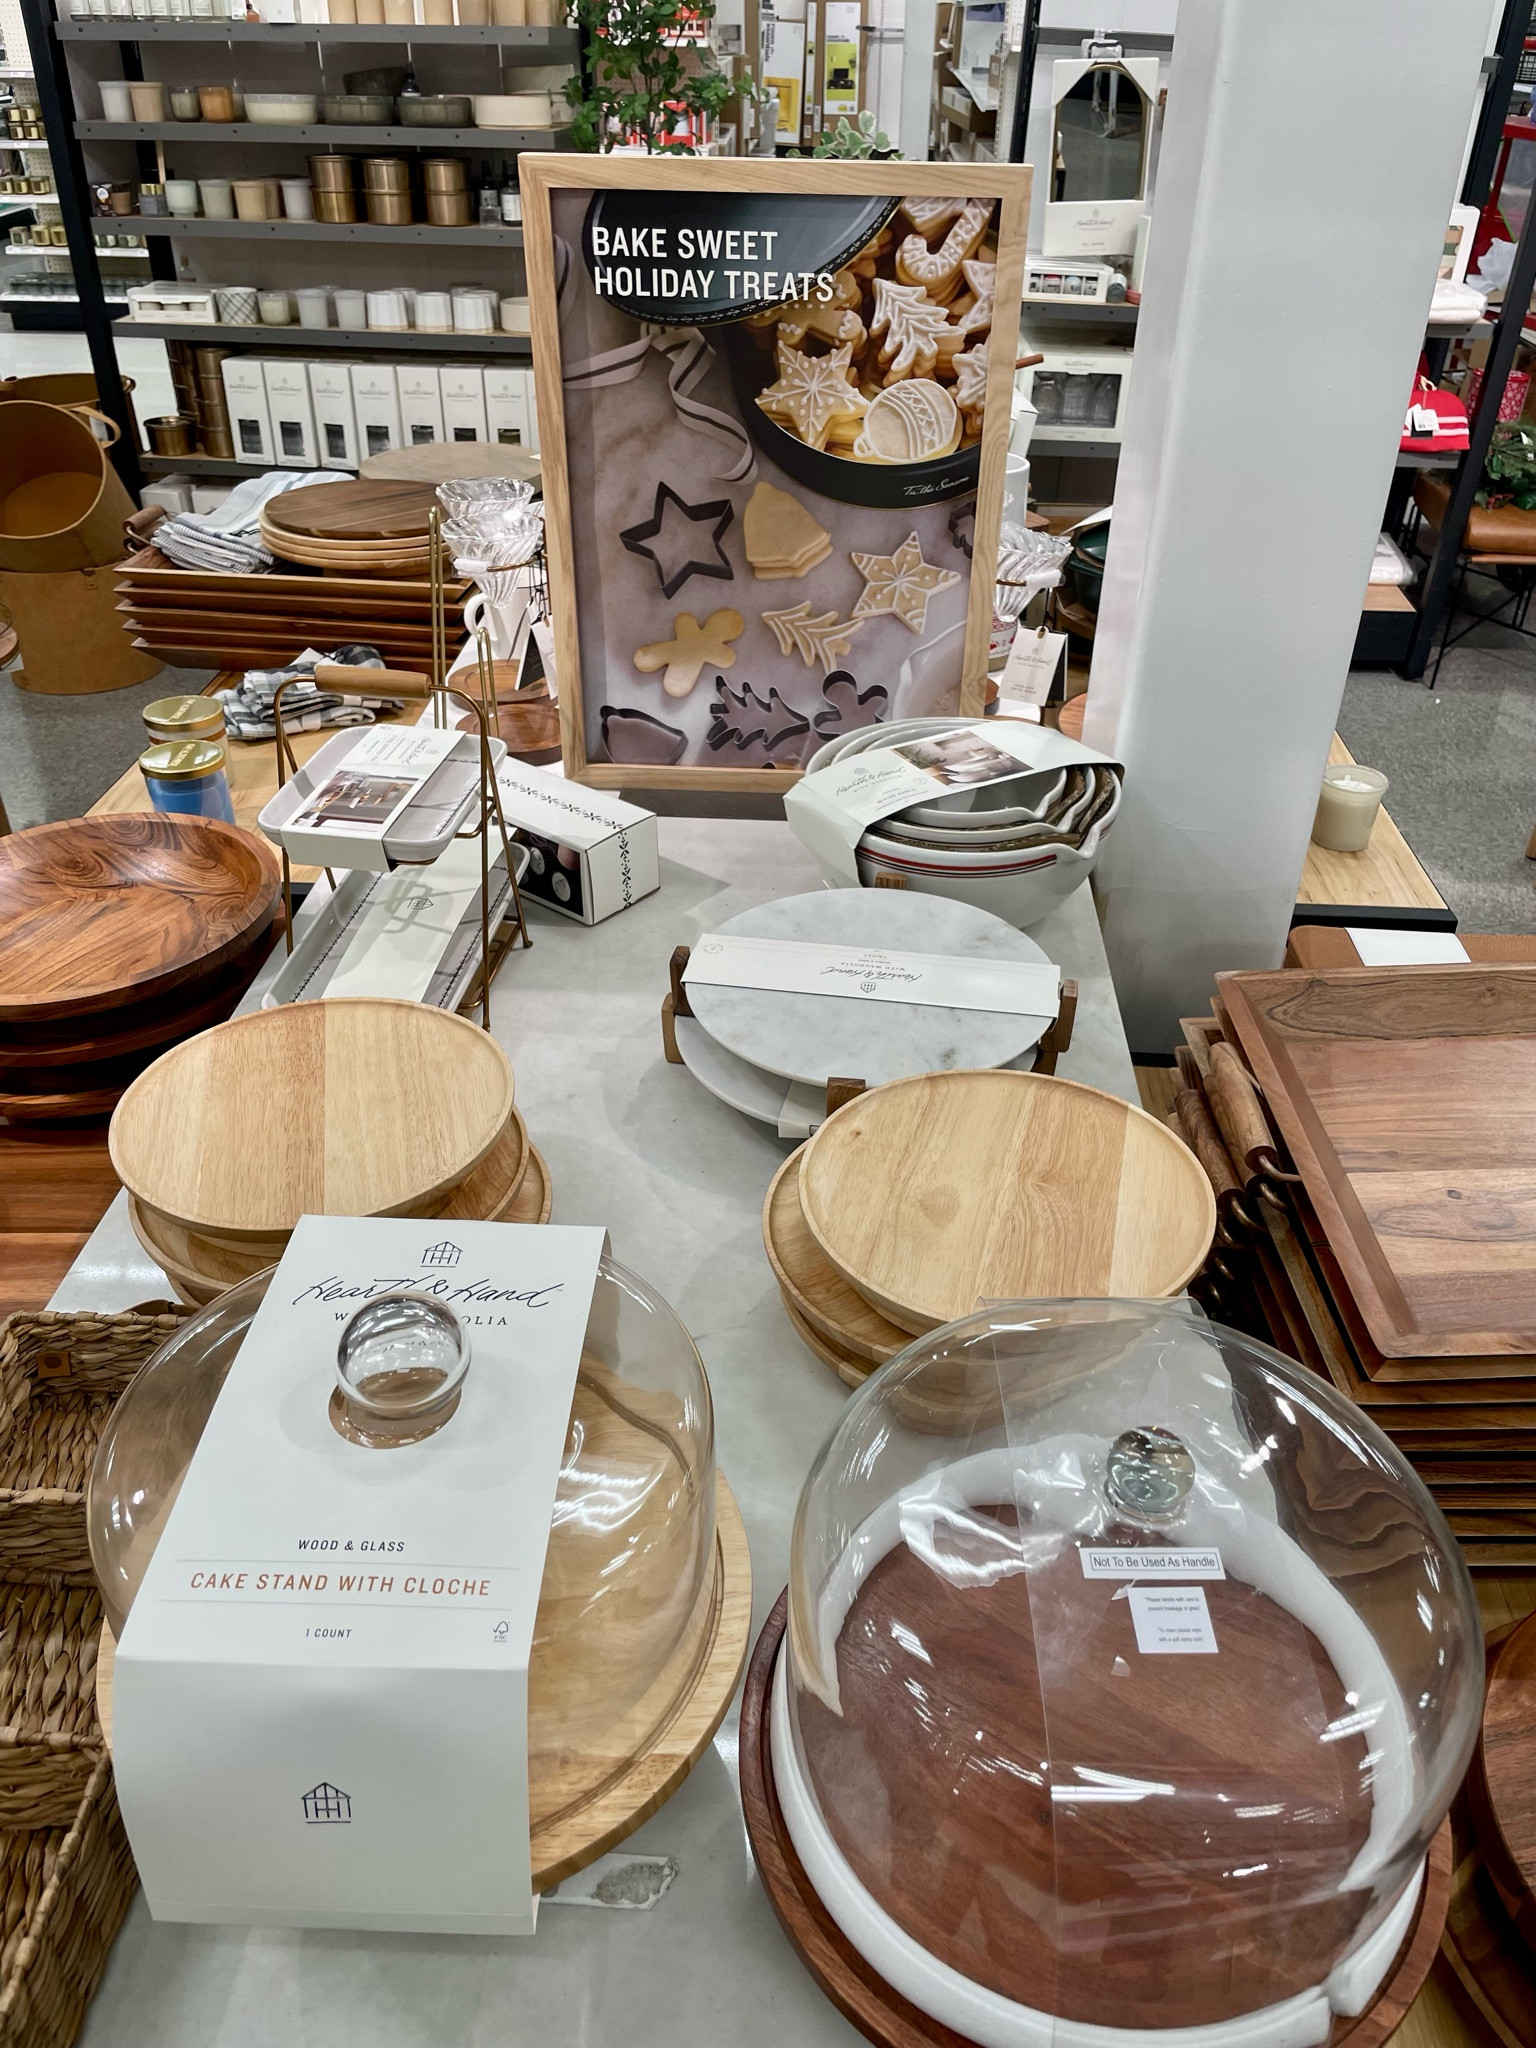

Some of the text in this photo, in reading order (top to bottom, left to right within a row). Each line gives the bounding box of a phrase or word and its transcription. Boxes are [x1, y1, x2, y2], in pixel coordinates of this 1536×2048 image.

[592, 226, 779, 261] BAKE SWEET
[594, 266, 835, 302] HOLIDAY TREATS
[424, 1278, 449, 1295] &
[298, 1539, 405, 1552] WOOD & GLASS
[1093, 1556, 1216, 1567] Not To Be Used As Handle
[190, 1572, 492, 1596] CAKE STAND WITH CLOCHE
[305, 1628, 352, 1639] 1 COUNT
